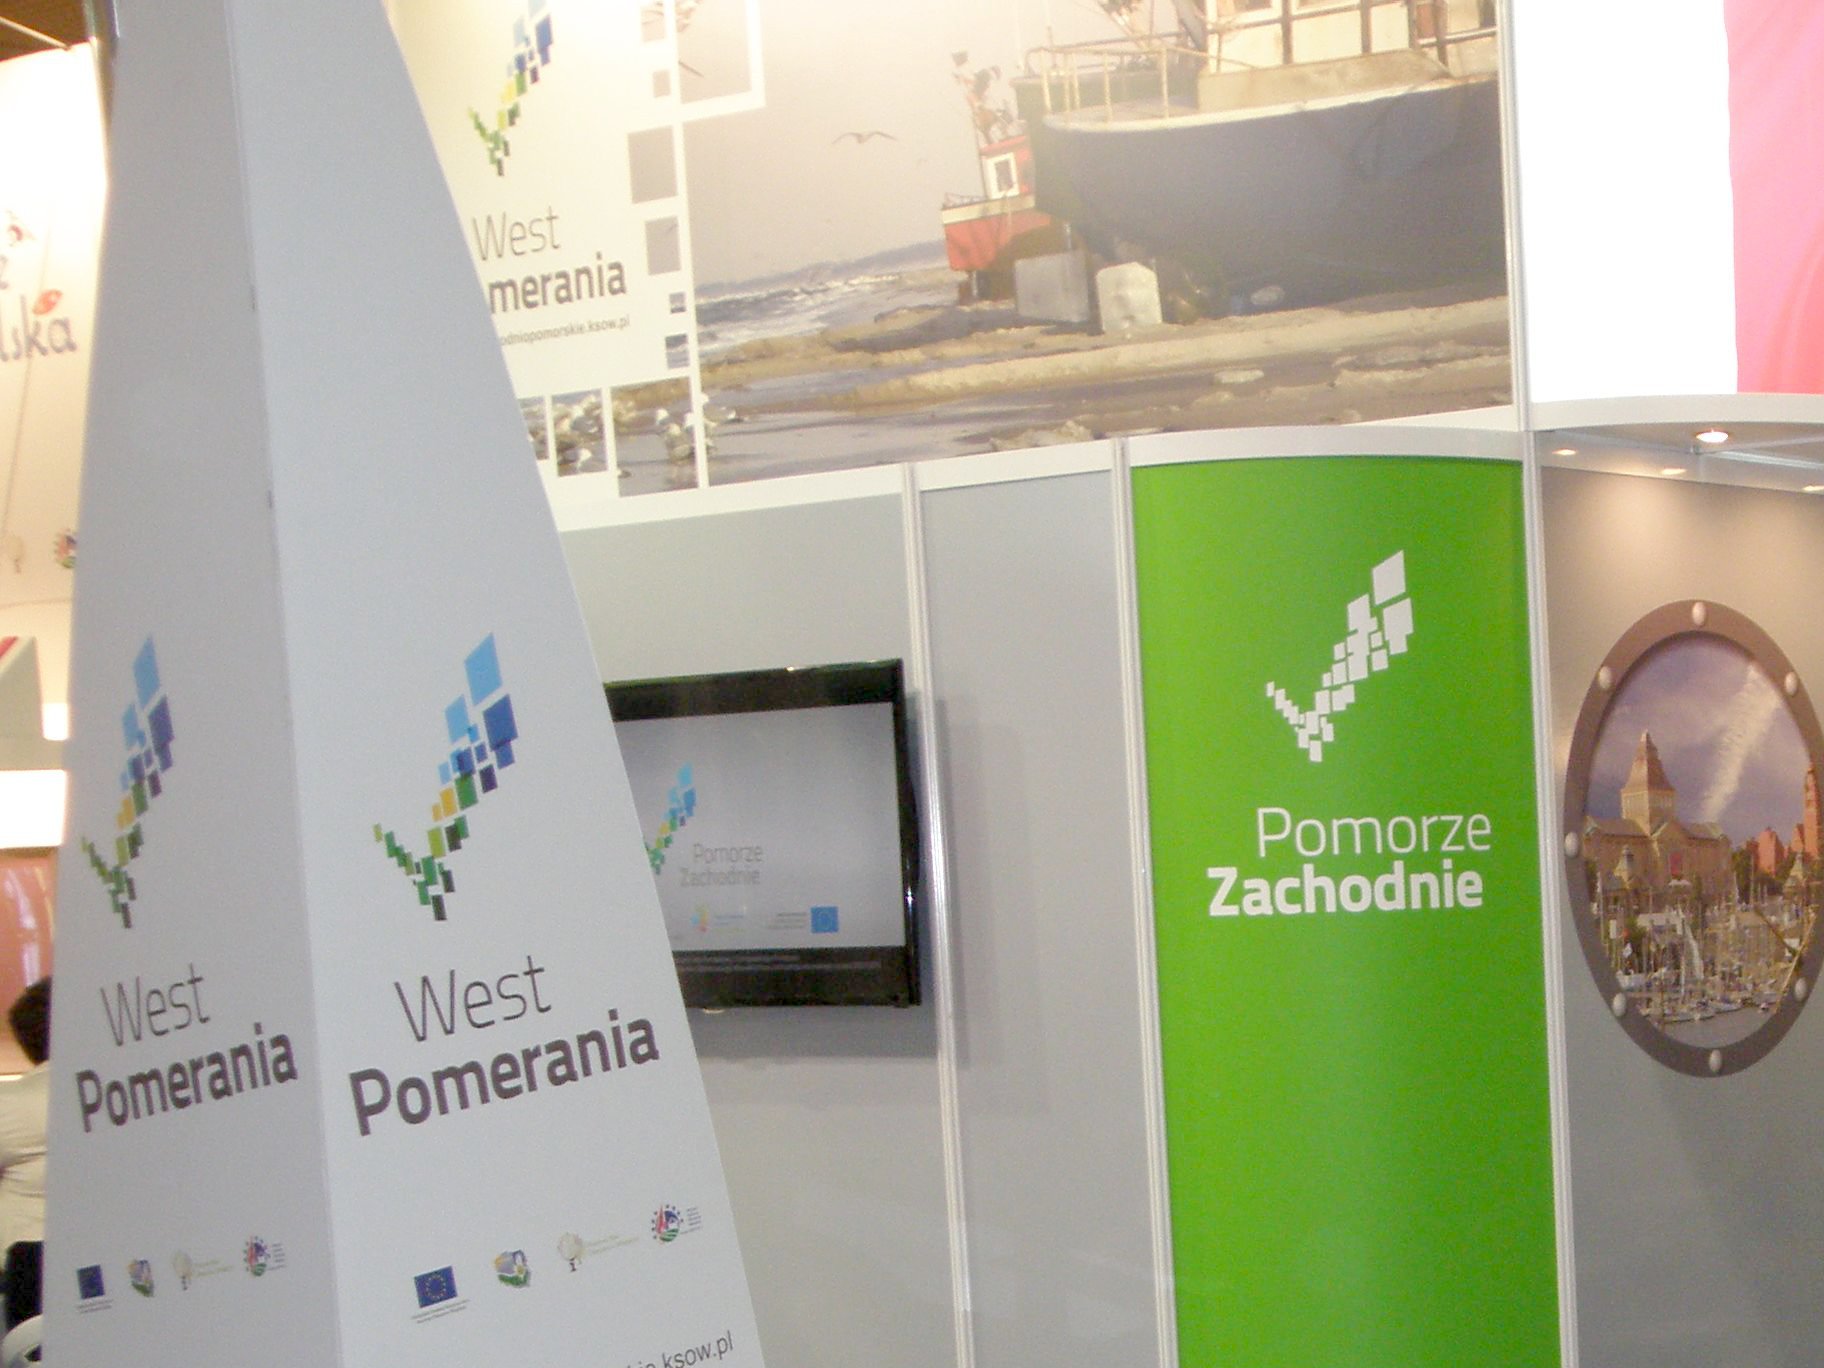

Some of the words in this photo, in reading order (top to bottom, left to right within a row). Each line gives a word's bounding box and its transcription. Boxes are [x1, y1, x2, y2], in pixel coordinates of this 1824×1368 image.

[472, 205, 560, 261] West
[488, 250, 627, 314] merania
[1256, 806, 1492, 858] Pomorze
[1206, 858, 1484, 917] Zachodnie
[100, 962, 211, 1047] West
[394, 954, 552, 1042] West
[75, 1021, 298, 1134] Pomerania
[348, 1007, 660, 1137] Pomerania
